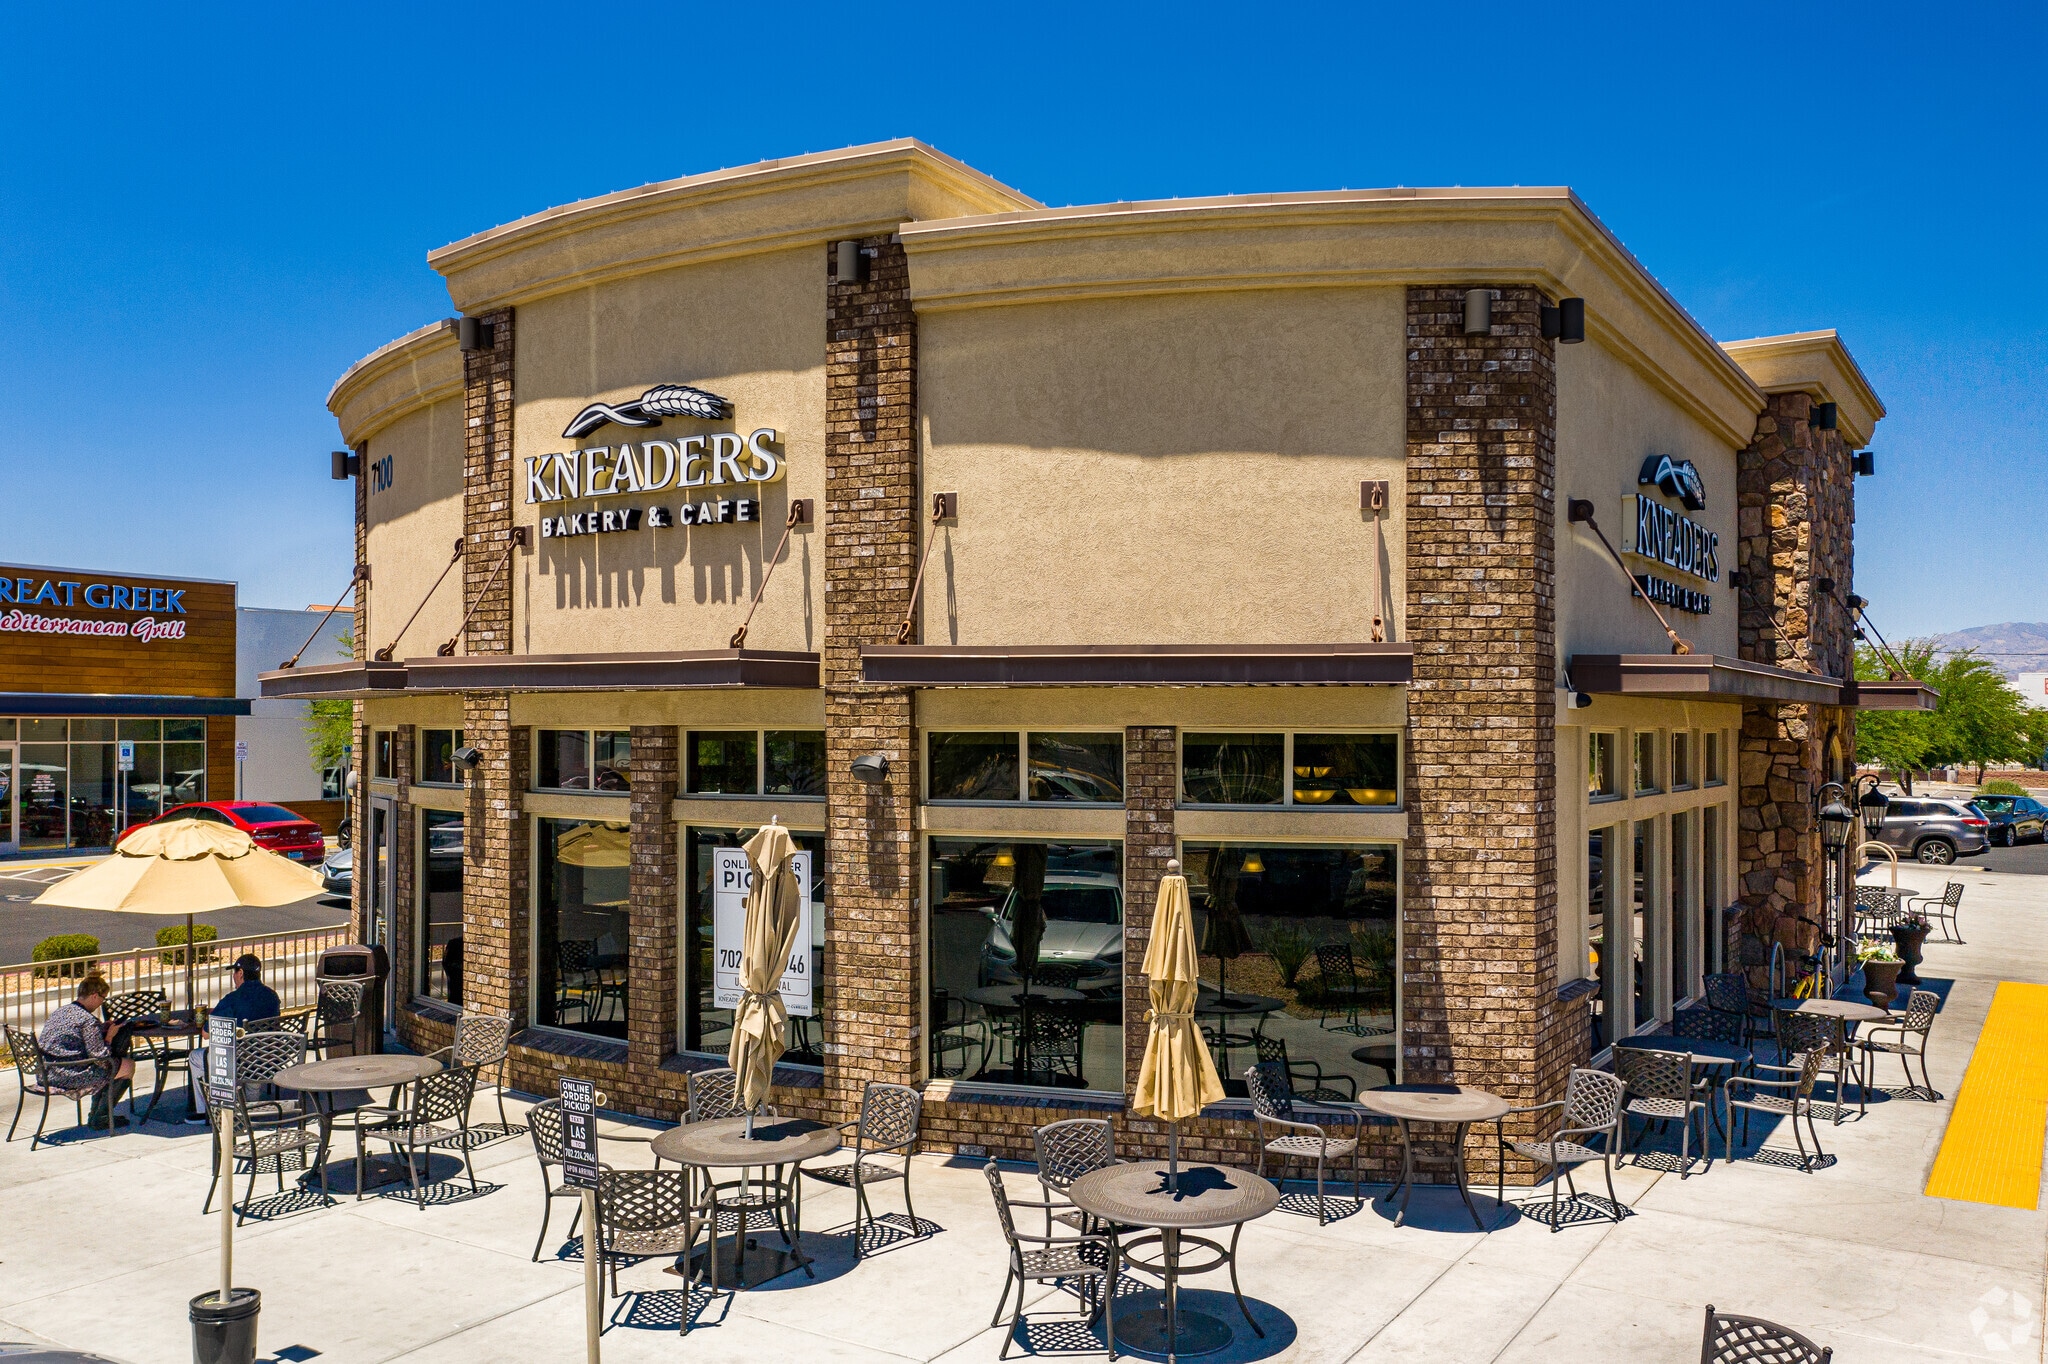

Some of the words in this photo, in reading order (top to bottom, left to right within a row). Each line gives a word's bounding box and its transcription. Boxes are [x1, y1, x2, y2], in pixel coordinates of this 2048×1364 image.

[524, 428, 778, 504] KNEADERS
[371, 454, 393, 496] 7100
[542, 508, 633, 538] BAKERY
[647, 505, 662, 527] &
[680, 499, 750, 525] CAFE
[1637, 493, 1719, 582] KNEADERS
[1646, 574, 1680, 608] BAKERY
[84, 583, 187, 614] GREEK
[0, 609, 128, 636] editerranean
[131, 616, 186, 643] Grill
[723, 859, 750, 869] ONLI
[211, 1020, 232, 1029] ONLINE
[212, 1028, 232, 1037] ORDER
[212, 1035, 231, 1045] PICKUP
[215, 1056, 227, 1068] LAS
[562, 1082, 590, 1094] ONLINE
[563, 1091, 590, 1103] ORDER
[564, 1100, 590, 1112] PICKUP
[570, 1125, 586, 1140] LAS
[566, 1164, 577, 1173] UPON
